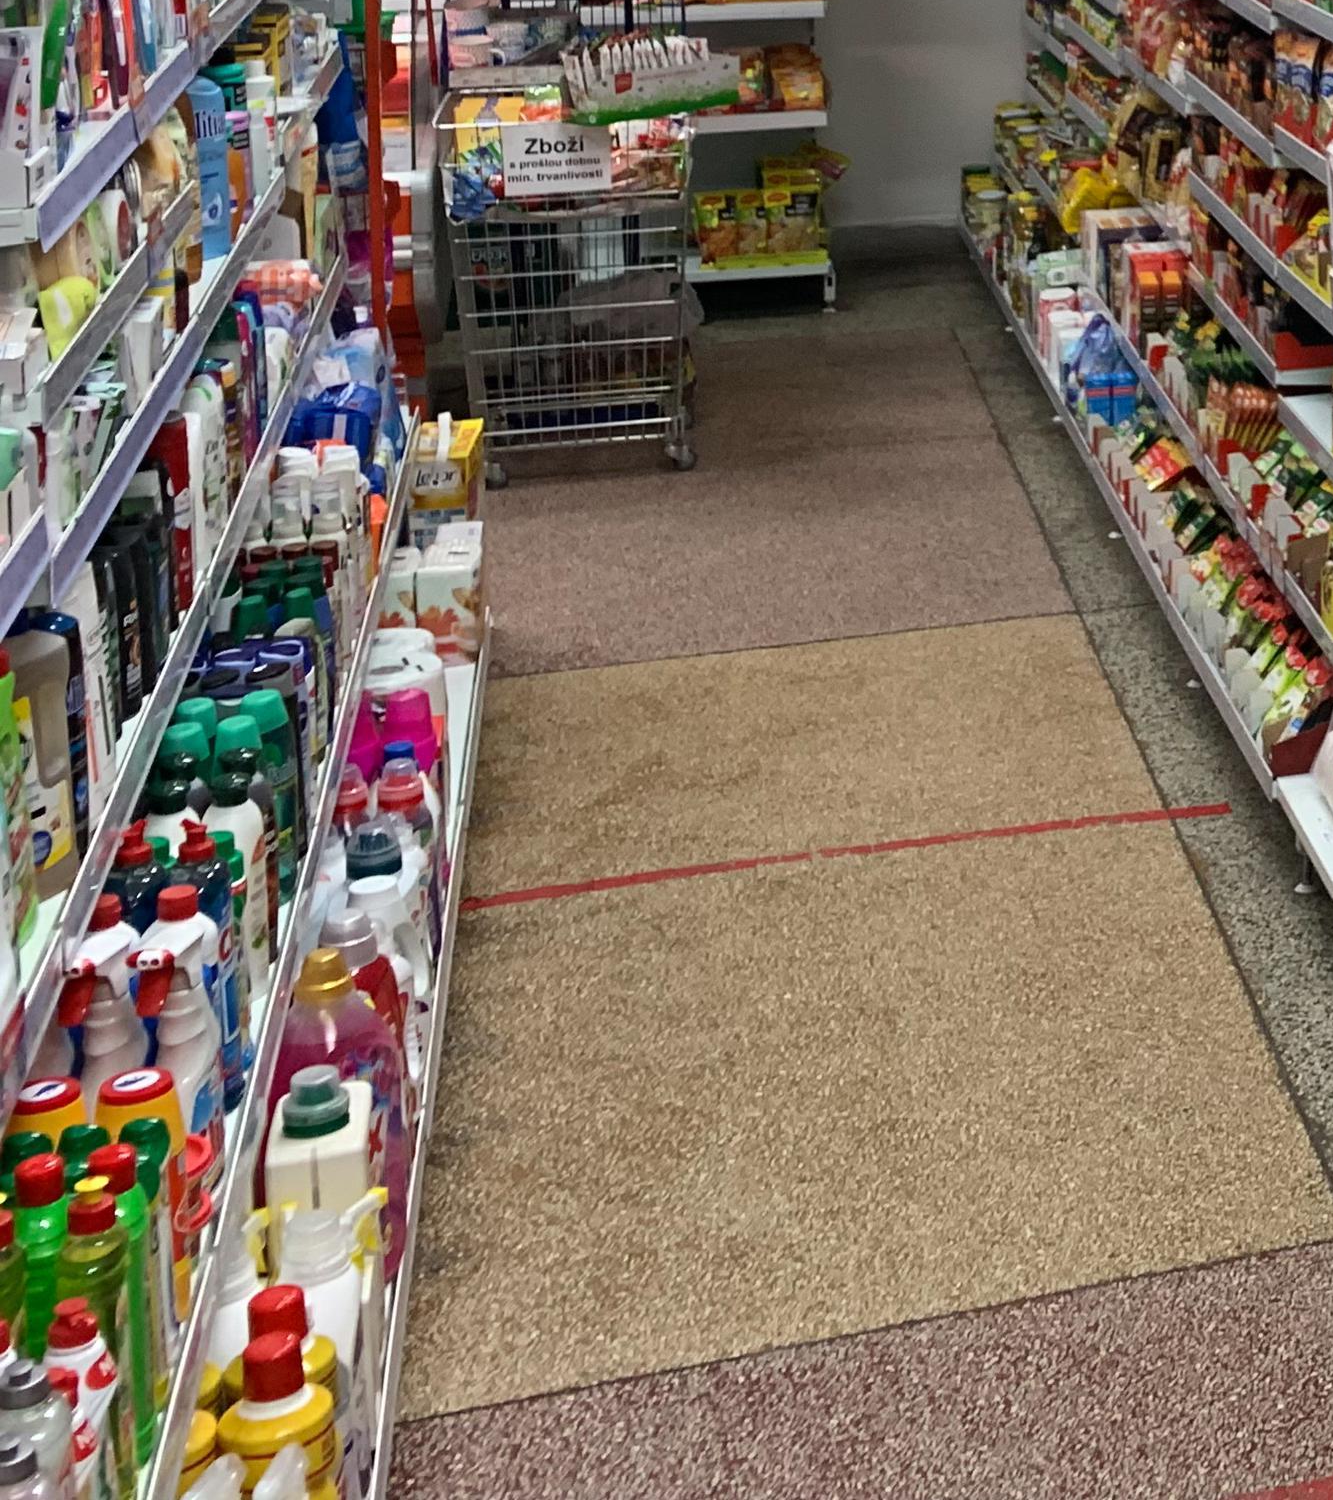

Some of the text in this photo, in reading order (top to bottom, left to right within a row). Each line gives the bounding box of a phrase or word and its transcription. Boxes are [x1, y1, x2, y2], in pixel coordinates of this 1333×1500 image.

[523, 135, 585, 156] Zboží
[519, 158, 562, 171] prošlou
[536, 168, 604, 182] trvanlivosti
[415, 469, 456, 487] Leor
